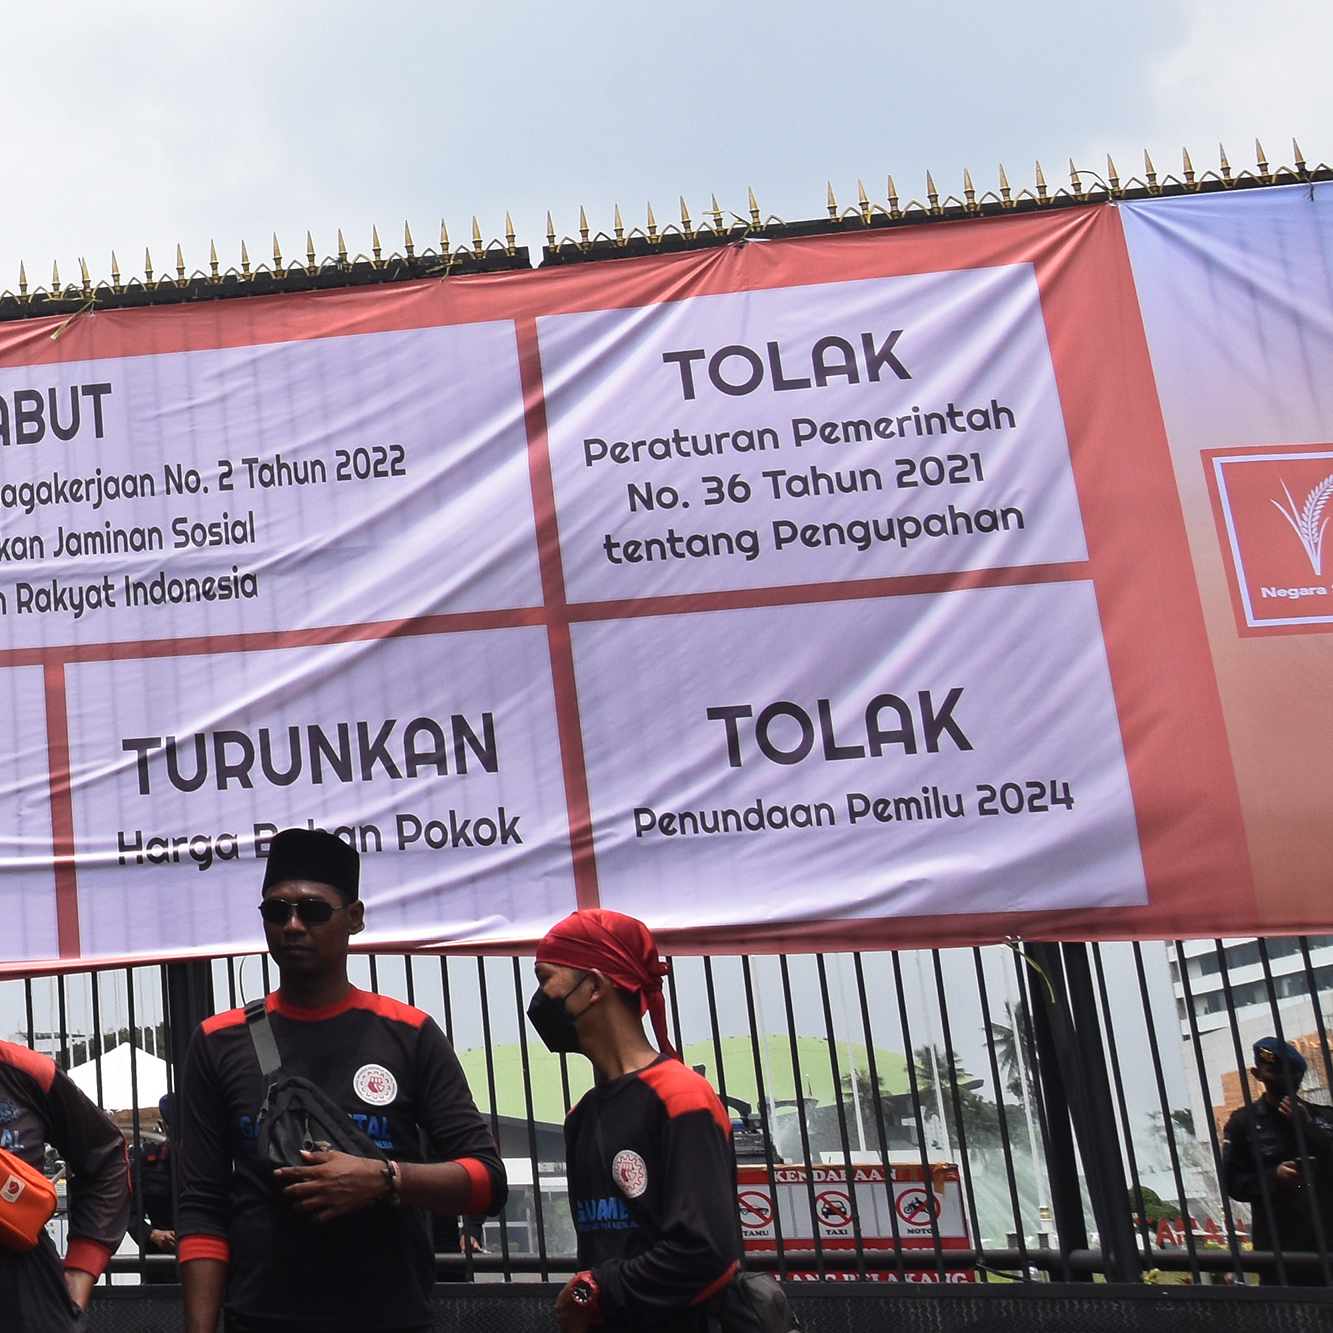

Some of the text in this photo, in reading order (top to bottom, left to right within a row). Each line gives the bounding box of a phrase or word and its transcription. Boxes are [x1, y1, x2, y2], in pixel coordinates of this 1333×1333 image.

[662, 329, 913, 401] TOLAK
[583, 398, 1017, 467] Peraturan Pemerintah
[164, 461, 210, 499] No.
[217, 459, 234, 493] 2
[241, 450, 327, 490] Tahun
[335, 443, 407, 480] 2022
[627, 451, 985, 513] No. 36 Tahun 2021
[53, 516, 164, 558] Jaminan
[171, 510, 256, 549] Sosial
[603, 502, 1026, 565] tentang Pengupahan
[16, 574, 116, 620] Rakyat
[125, 565, 258, 609] Indonesia
[1260, 585, 1327, 600] Negara
[122, 711, 500, 796] TURUNKAN
[706, 686, 975, 769] TOLAK
[117, 806, 524, 871] Harga Ban Pokok
[634, 779, 1075, 839] Penundaan Pemilu 2024
[825, 1228, 849, 1236] TAXI
[906, 1227, 940, 1235] MOTO
